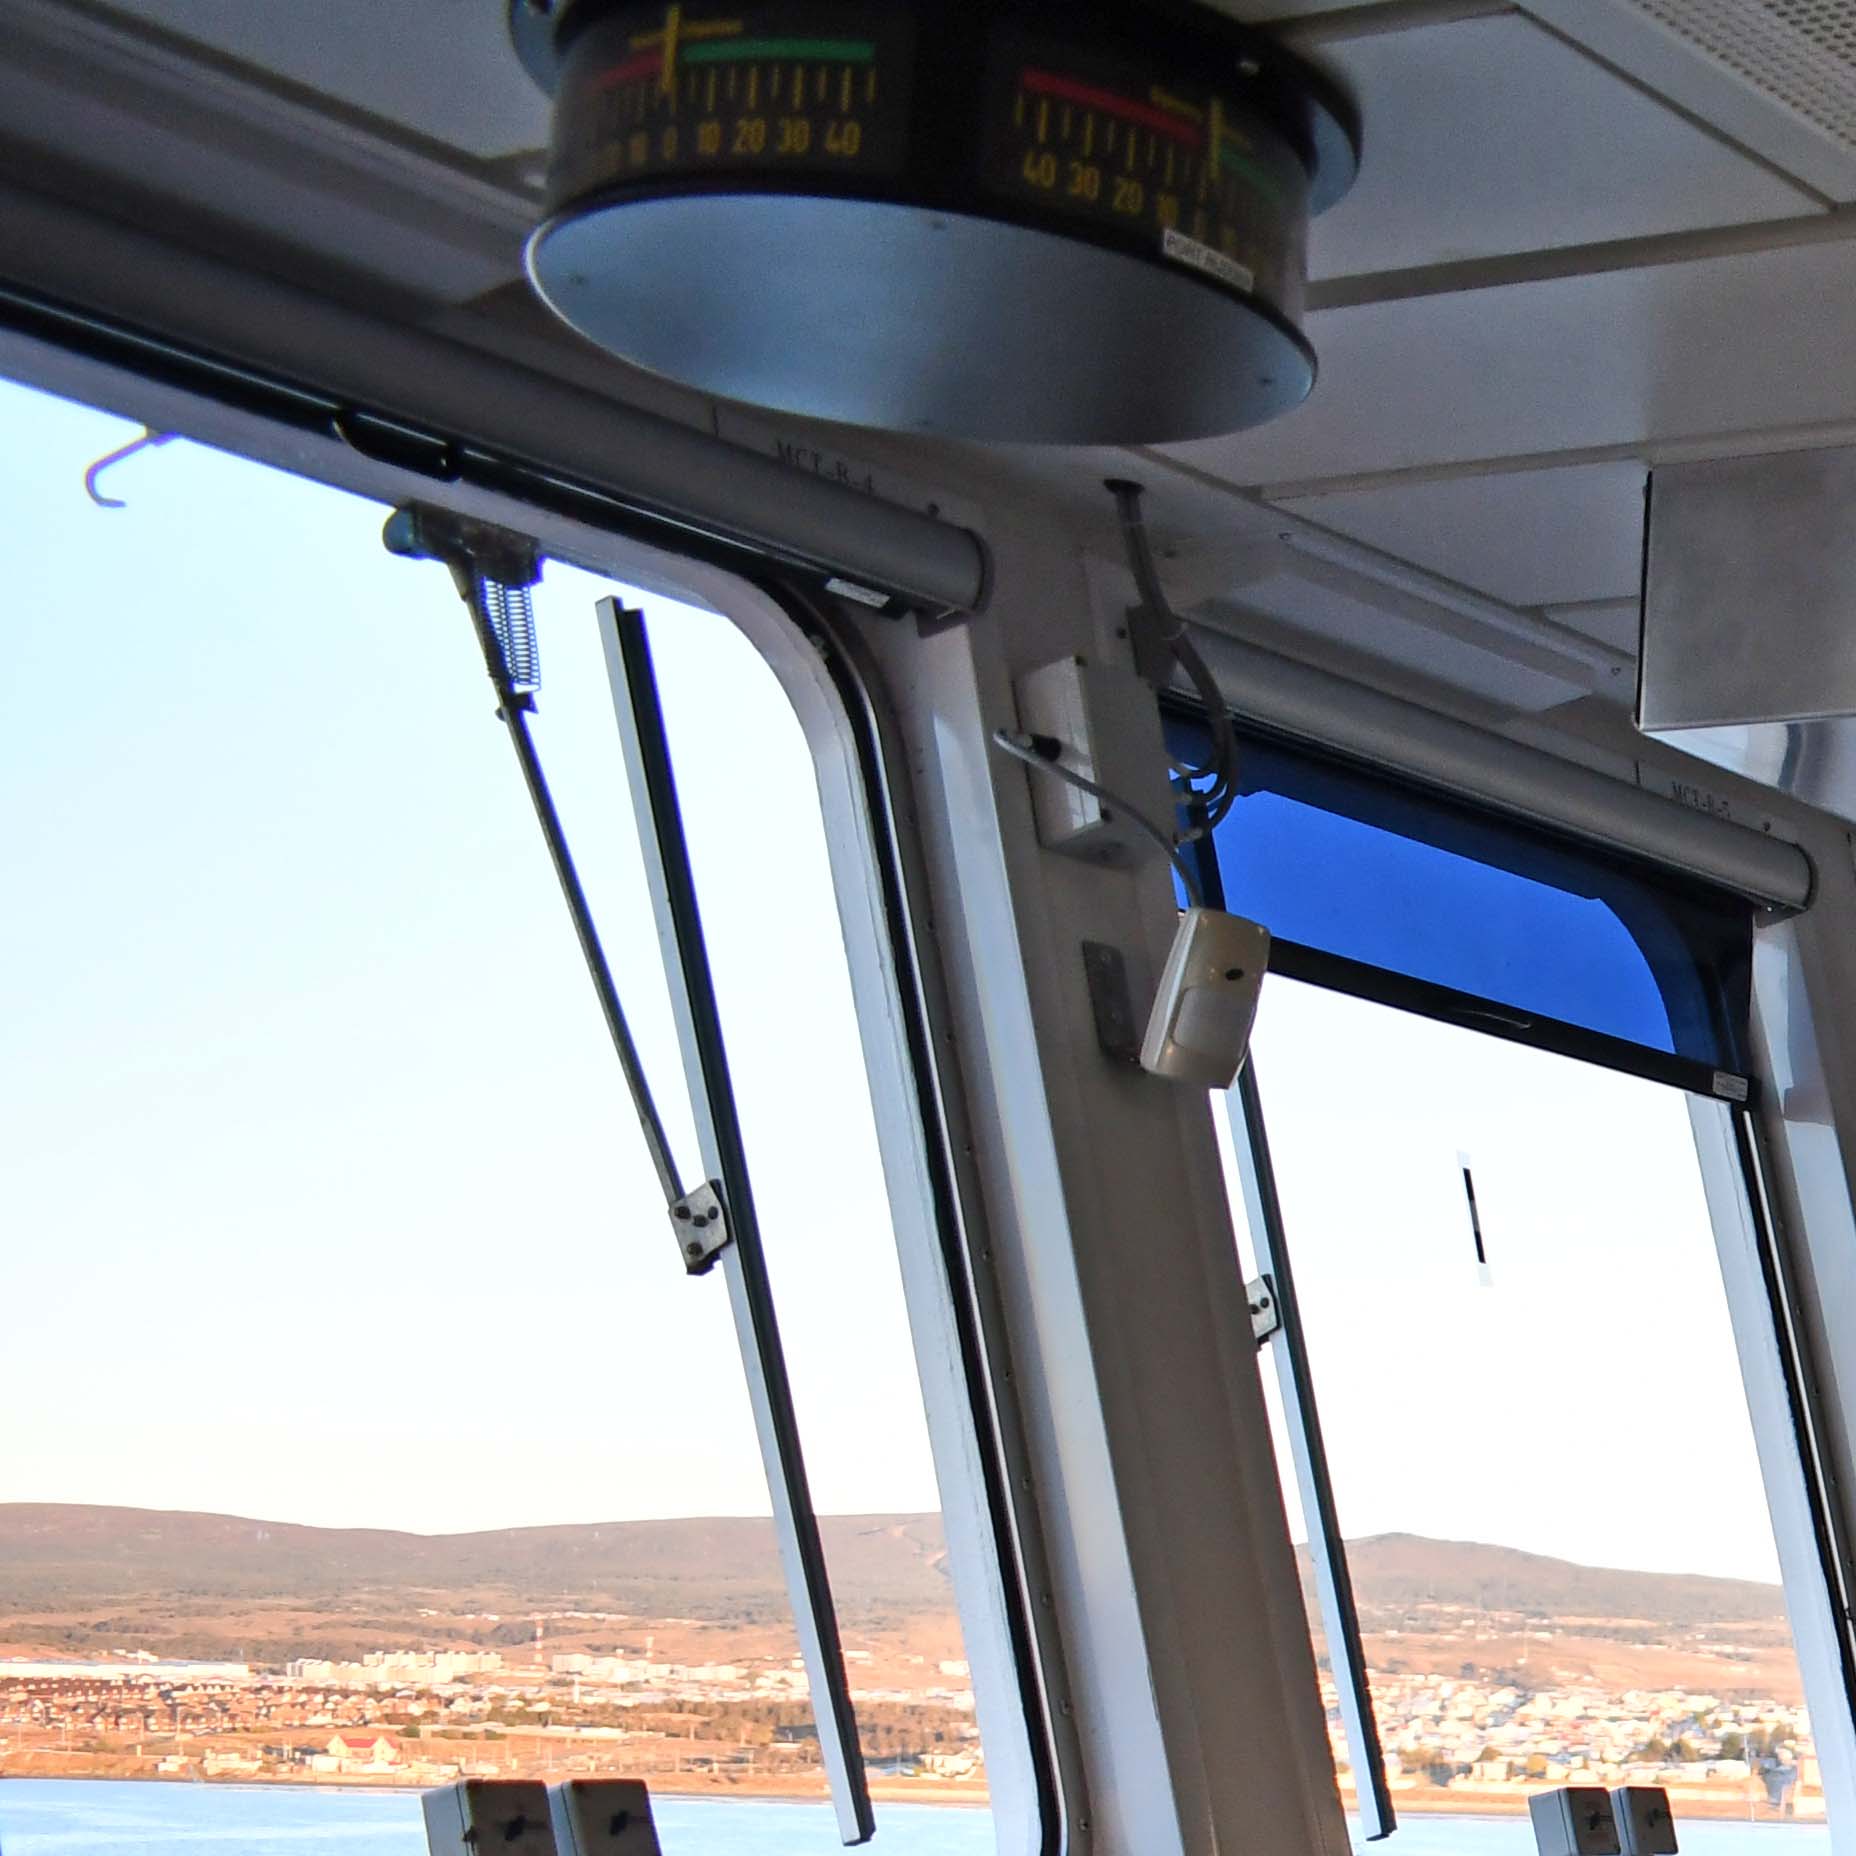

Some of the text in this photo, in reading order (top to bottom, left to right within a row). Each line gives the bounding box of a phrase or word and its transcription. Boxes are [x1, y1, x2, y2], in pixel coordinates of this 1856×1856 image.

[733, 117, 767, 156] 20
[778, 117, 811, 156] 30
[825, 119, 862, 156] 40
[1023, 149, 1057, 190] 40
[1069, 159, 1100, 201] 30
